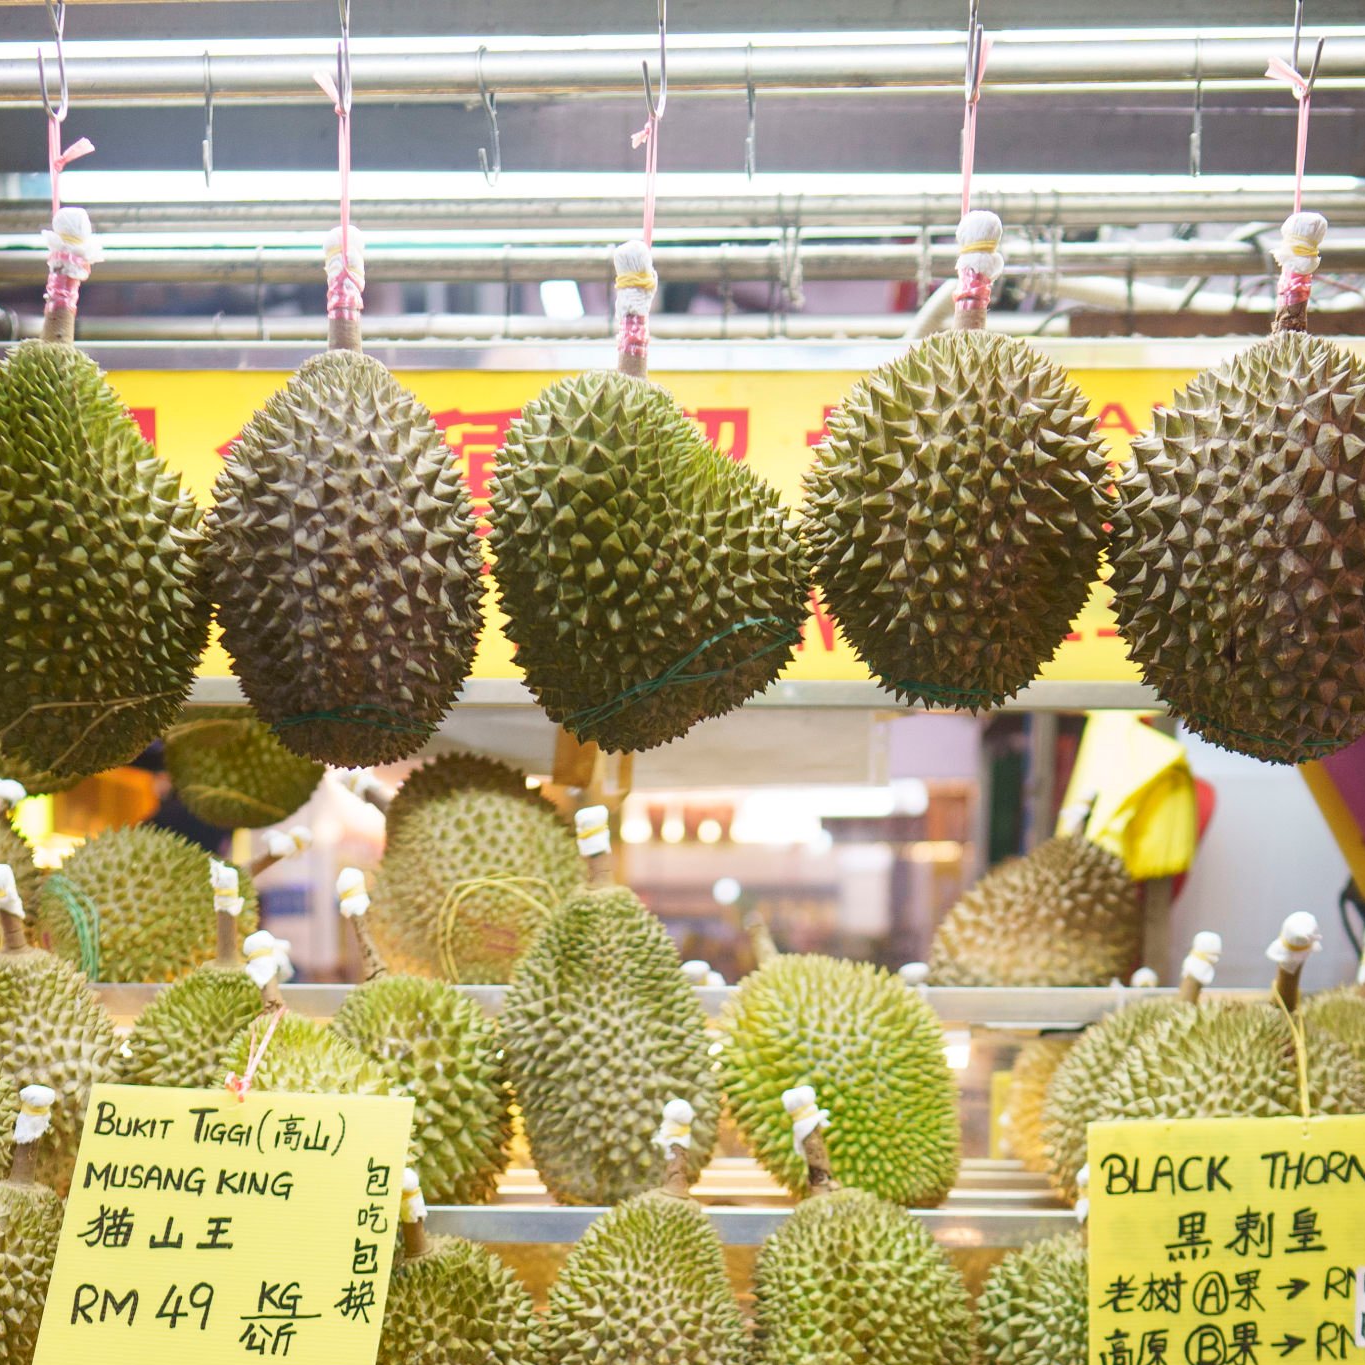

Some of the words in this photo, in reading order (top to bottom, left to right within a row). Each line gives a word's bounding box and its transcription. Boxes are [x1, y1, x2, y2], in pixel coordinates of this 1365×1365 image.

[94, 1101, 175, 1140] BUKIT
[189, 1108, 253, 1144] TIGGI
[83, 1161, 206, 1196] MUSANG
[215, 1169, 295, 1201] KING
[1101, 1153, 1233, 1195] BLACK
[77, 1205, 234, 1250] 猫山王
[334, 1157, 390, 1324] 包吃包换
[70, 1283, 139, 1326] RM
[155, 1281, 215, 1330] 49
[257, 1280, 304, 1317] KG
[239, 1322, 297, 1357] 公斤
